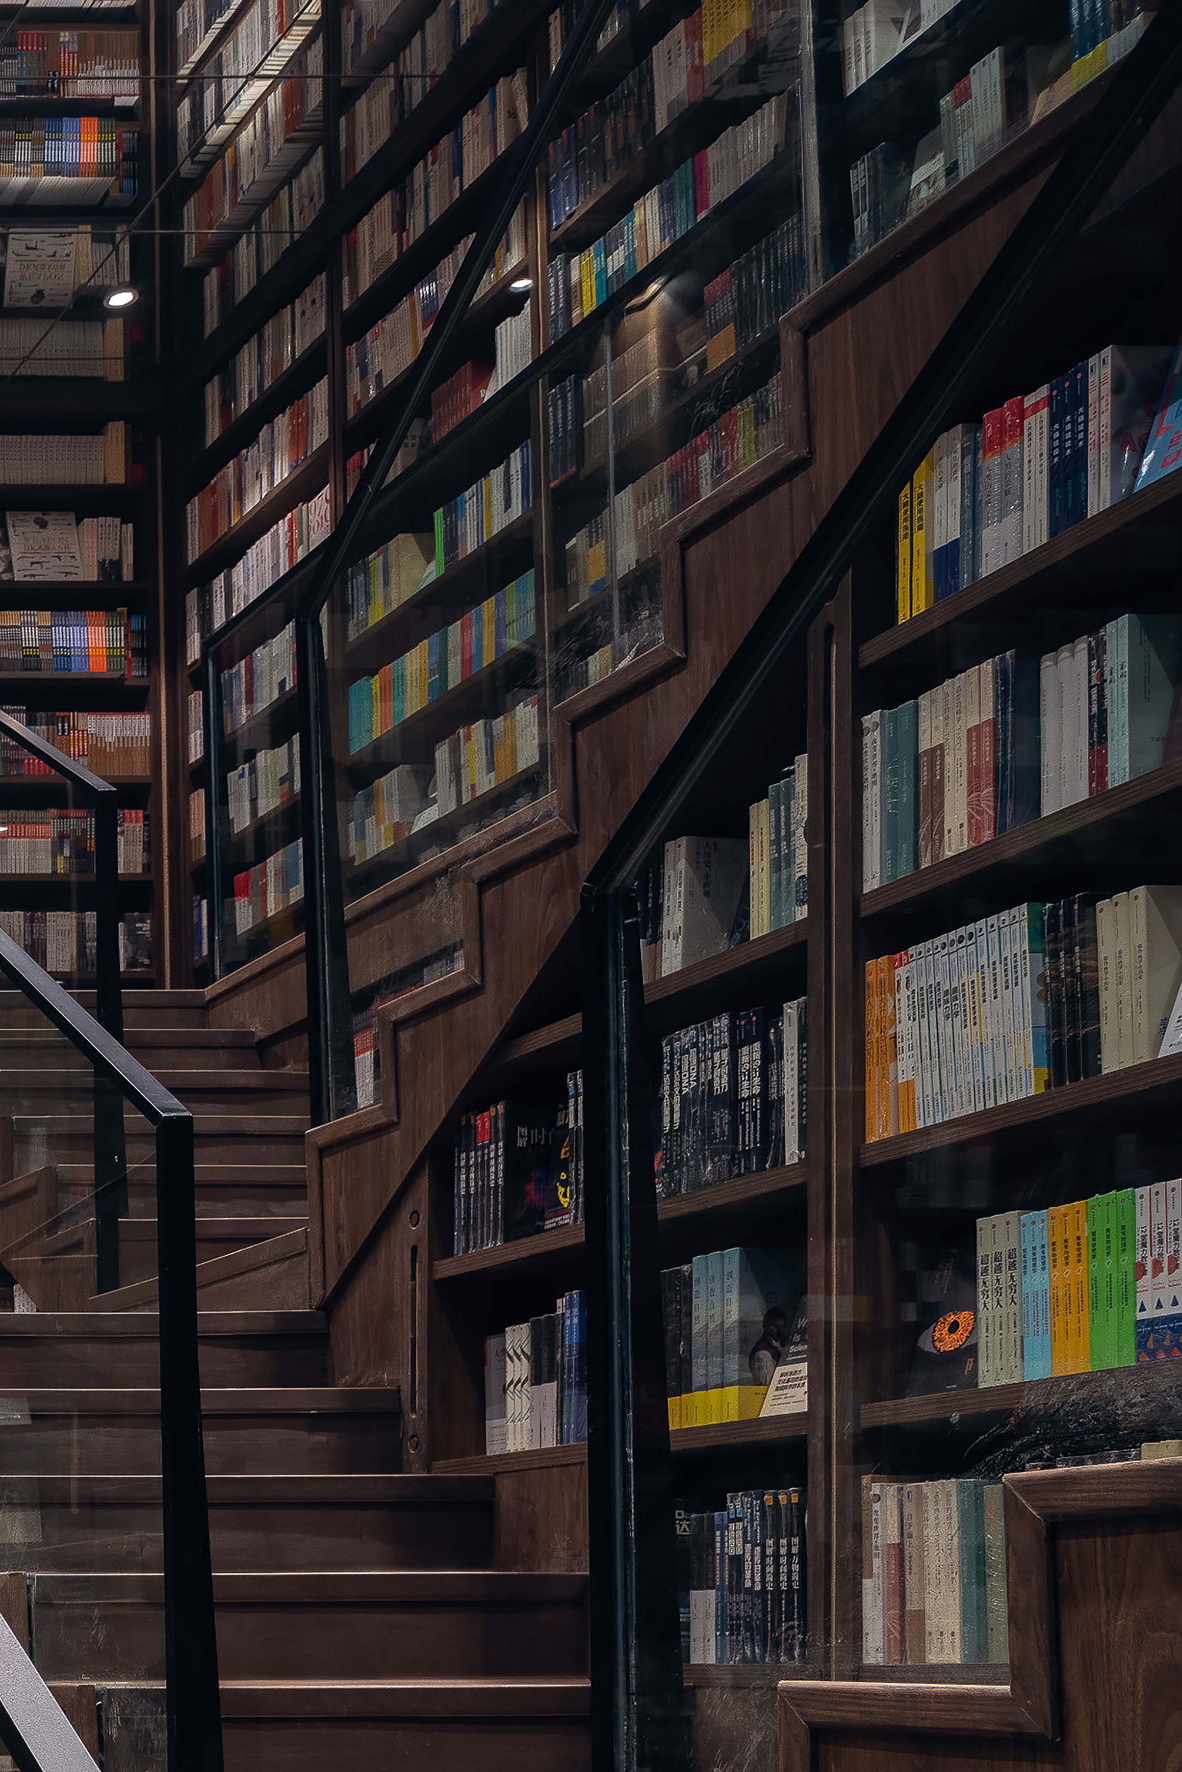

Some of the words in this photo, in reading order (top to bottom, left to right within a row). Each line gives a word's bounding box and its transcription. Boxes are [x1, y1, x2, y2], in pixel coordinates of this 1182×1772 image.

[980, 1253, 990, 1311] 超越无穷大
[994, 1251, 1003, 1309] 超越无穷大
[1007, 1247, 1017, 1306] 超越无穷大
